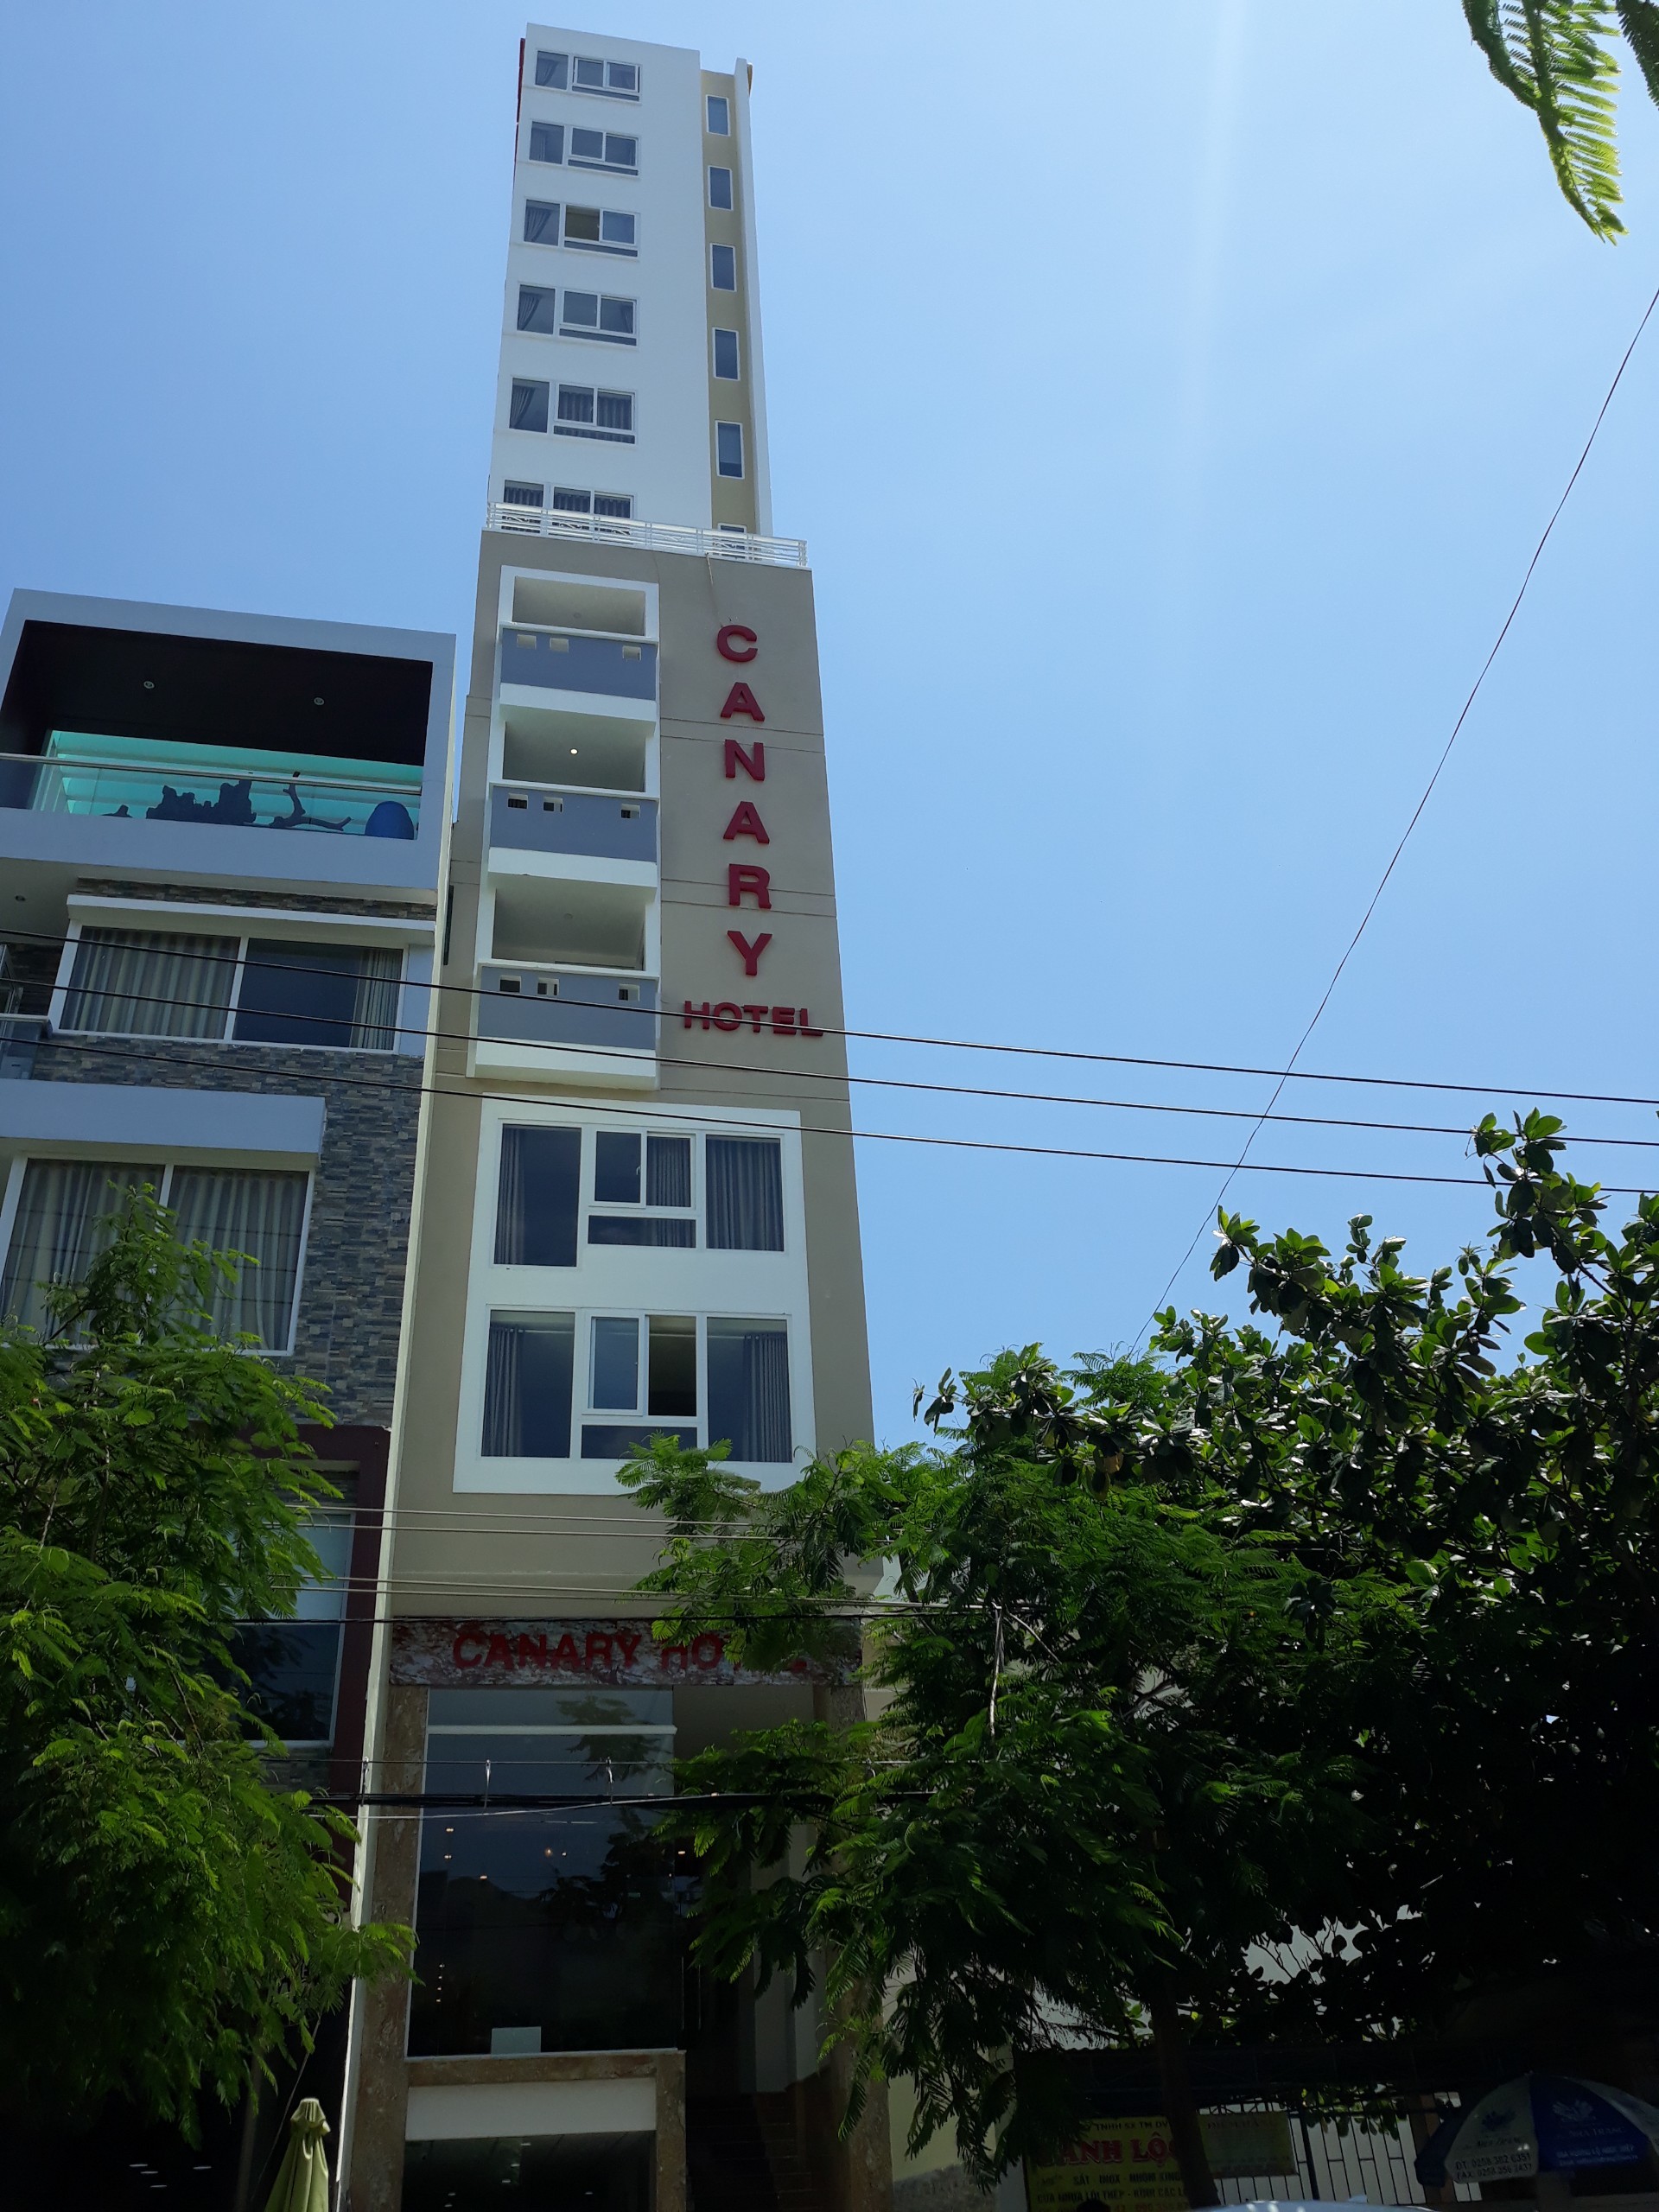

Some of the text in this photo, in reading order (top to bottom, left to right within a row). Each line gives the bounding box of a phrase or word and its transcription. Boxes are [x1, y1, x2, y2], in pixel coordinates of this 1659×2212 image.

[716, 624, 772, 976] CANARY
[684, 1001, 823, 1038] HOTEL
[452, 1633, 642, 1670] CANARY
